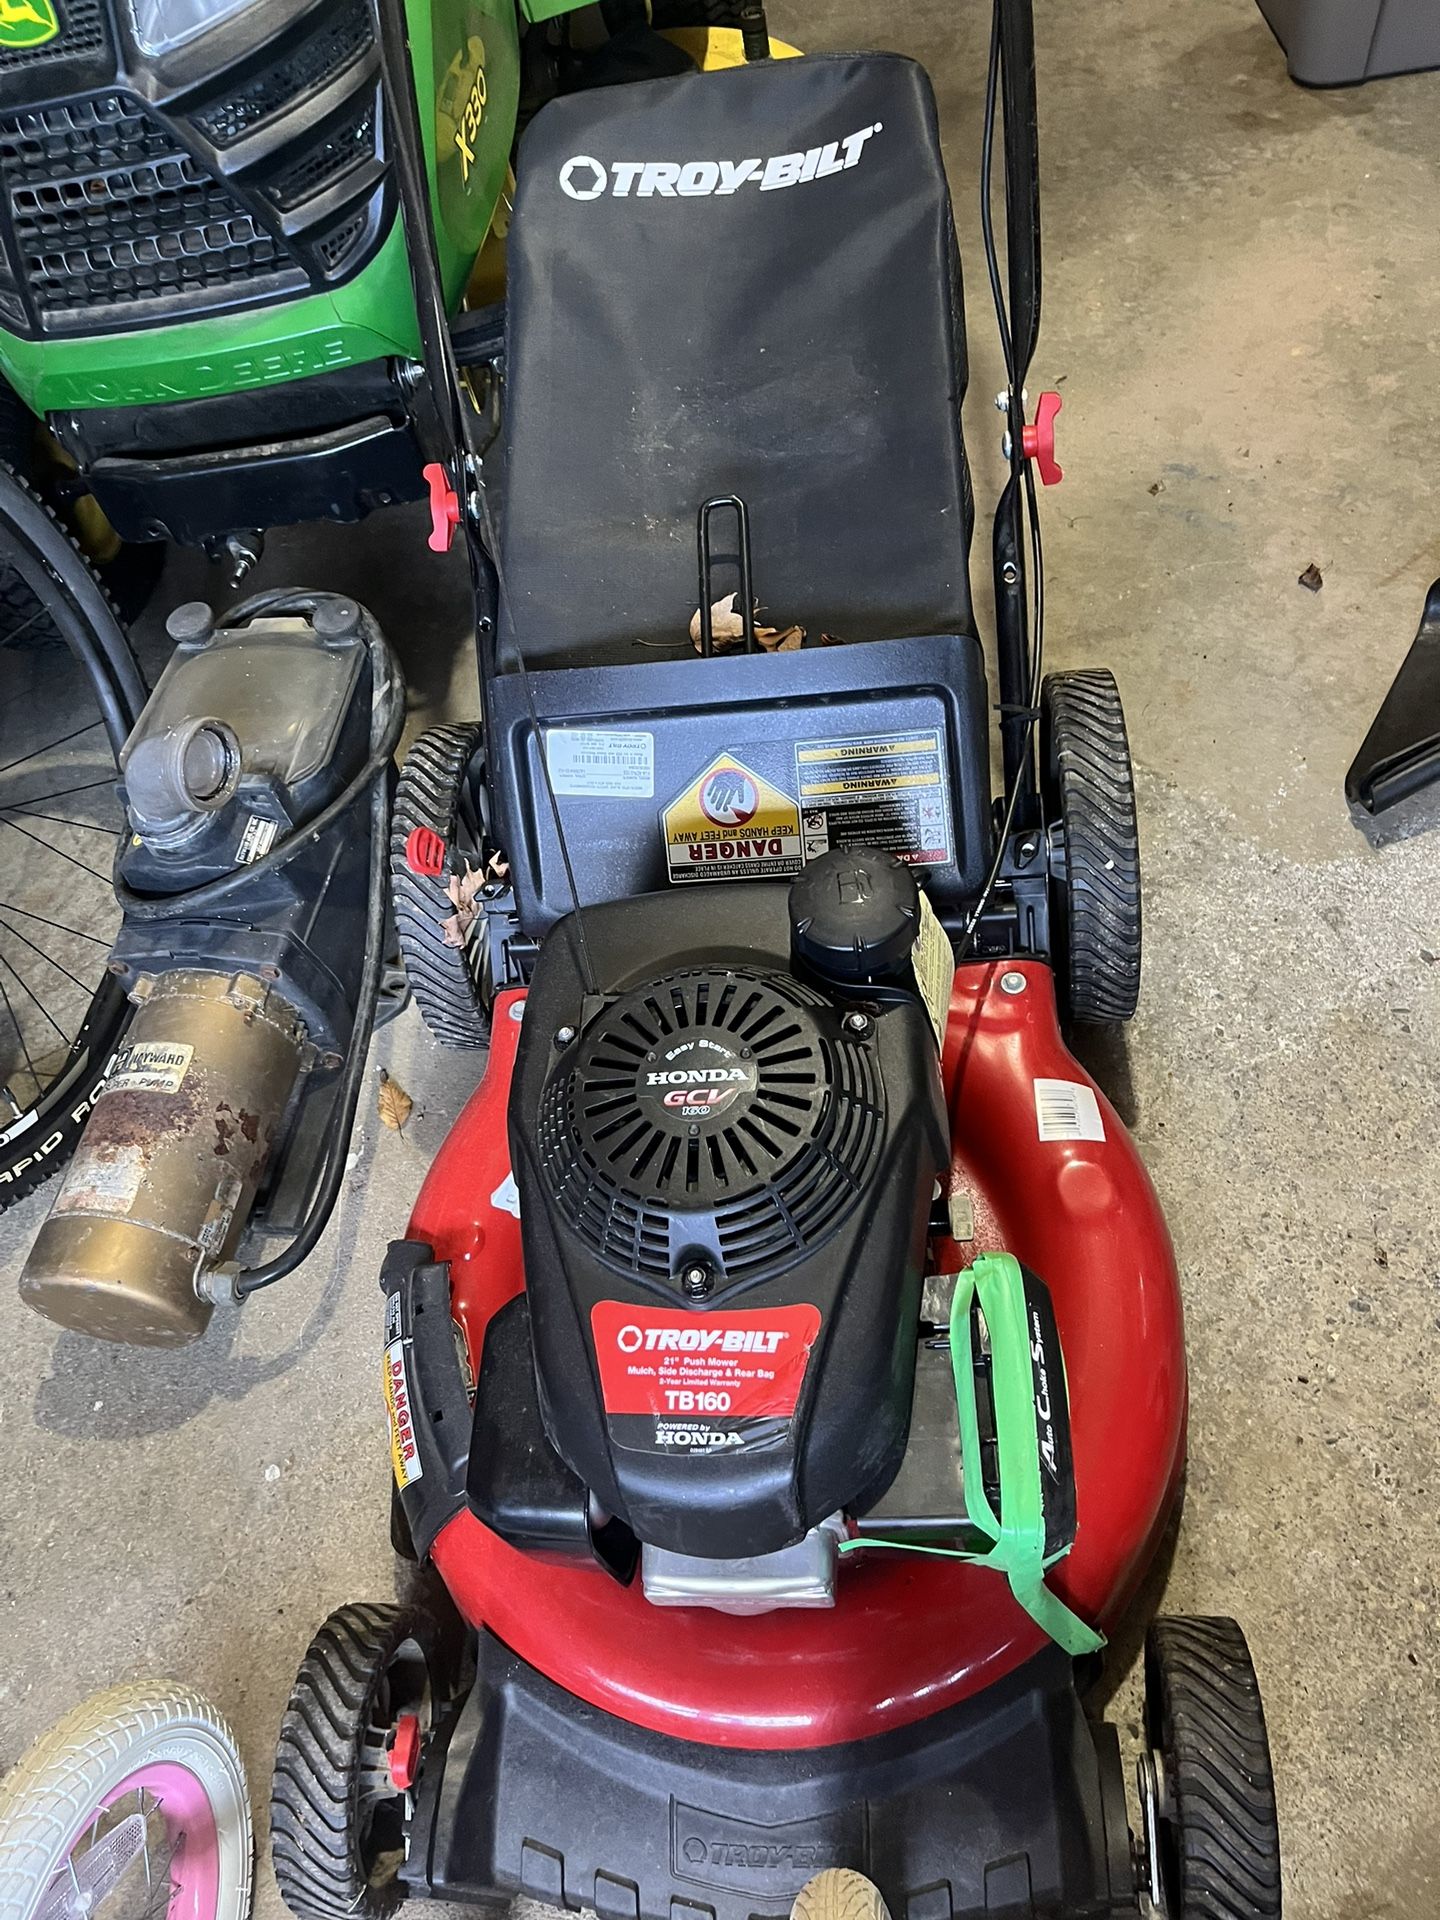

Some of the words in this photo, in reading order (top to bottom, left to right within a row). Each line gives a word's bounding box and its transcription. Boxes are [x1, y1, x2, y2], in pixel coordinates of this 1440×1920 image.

[454, 65, 487, 182] X330
[197, 341, 351, 391] DEERE
[841, 745, 890, 756] WARNING
[843, 778, 891, 790] WARNING
[673, 833, 697, 843] AWAY
[701, 831, 721, 840] FEET
[722, 829, 738, 838] and
[740, 827, 769, 838] HANDS
[771, 825, 794, 836] KEEP
[688, 838, 783, 861] DANGER
[700, 870, 731, 878] UNDAMAGED
[665, 1042, 695, 1061] Easy
[698, 1039, 737, 1059] Start
[646, 1068, 749, 1085] HONDA
[663, 1087, 737, 1107] GCV
[682, 1105, 711, 1116] 160
[643, 1328, 784, 1353] TROY-BILT
[1030, 1311, 1045, 1365] System
[663, 1356, 679, 1366] 21"
[683, 1356, 706, 1366] Push
[707, 1357, 738, 1367] Mower
[627, 1366, 657, 1376] Mulch,
[658, 1366, 678, 1376] Side
[679, 1367, 723, 1378] Discharge
[725, 1367, 733, 1377] &
[734, 1368, 756, 1378] Rear
[757, 1368, 775, 1380] Bag
[683, 1378, 709, 1386] Limited
[709, 1379, 741, 1388] Warranty
[665, 1390, 731, 1412] TB160
[1036, 1368, 1051, 1421] Choke
[392, 1360, 415, 1461] DANGER
[657, 1423, 699, 1431] POWERED
[700, 1424, 710, 1432] by
[655, 1431, 746, 1446] HONDA
[1041, 1424, 1058, 1473] Auto
[398, 1454, 408, 1479] AWAY
[710, 1842, 838, 1869] TROY-BI
